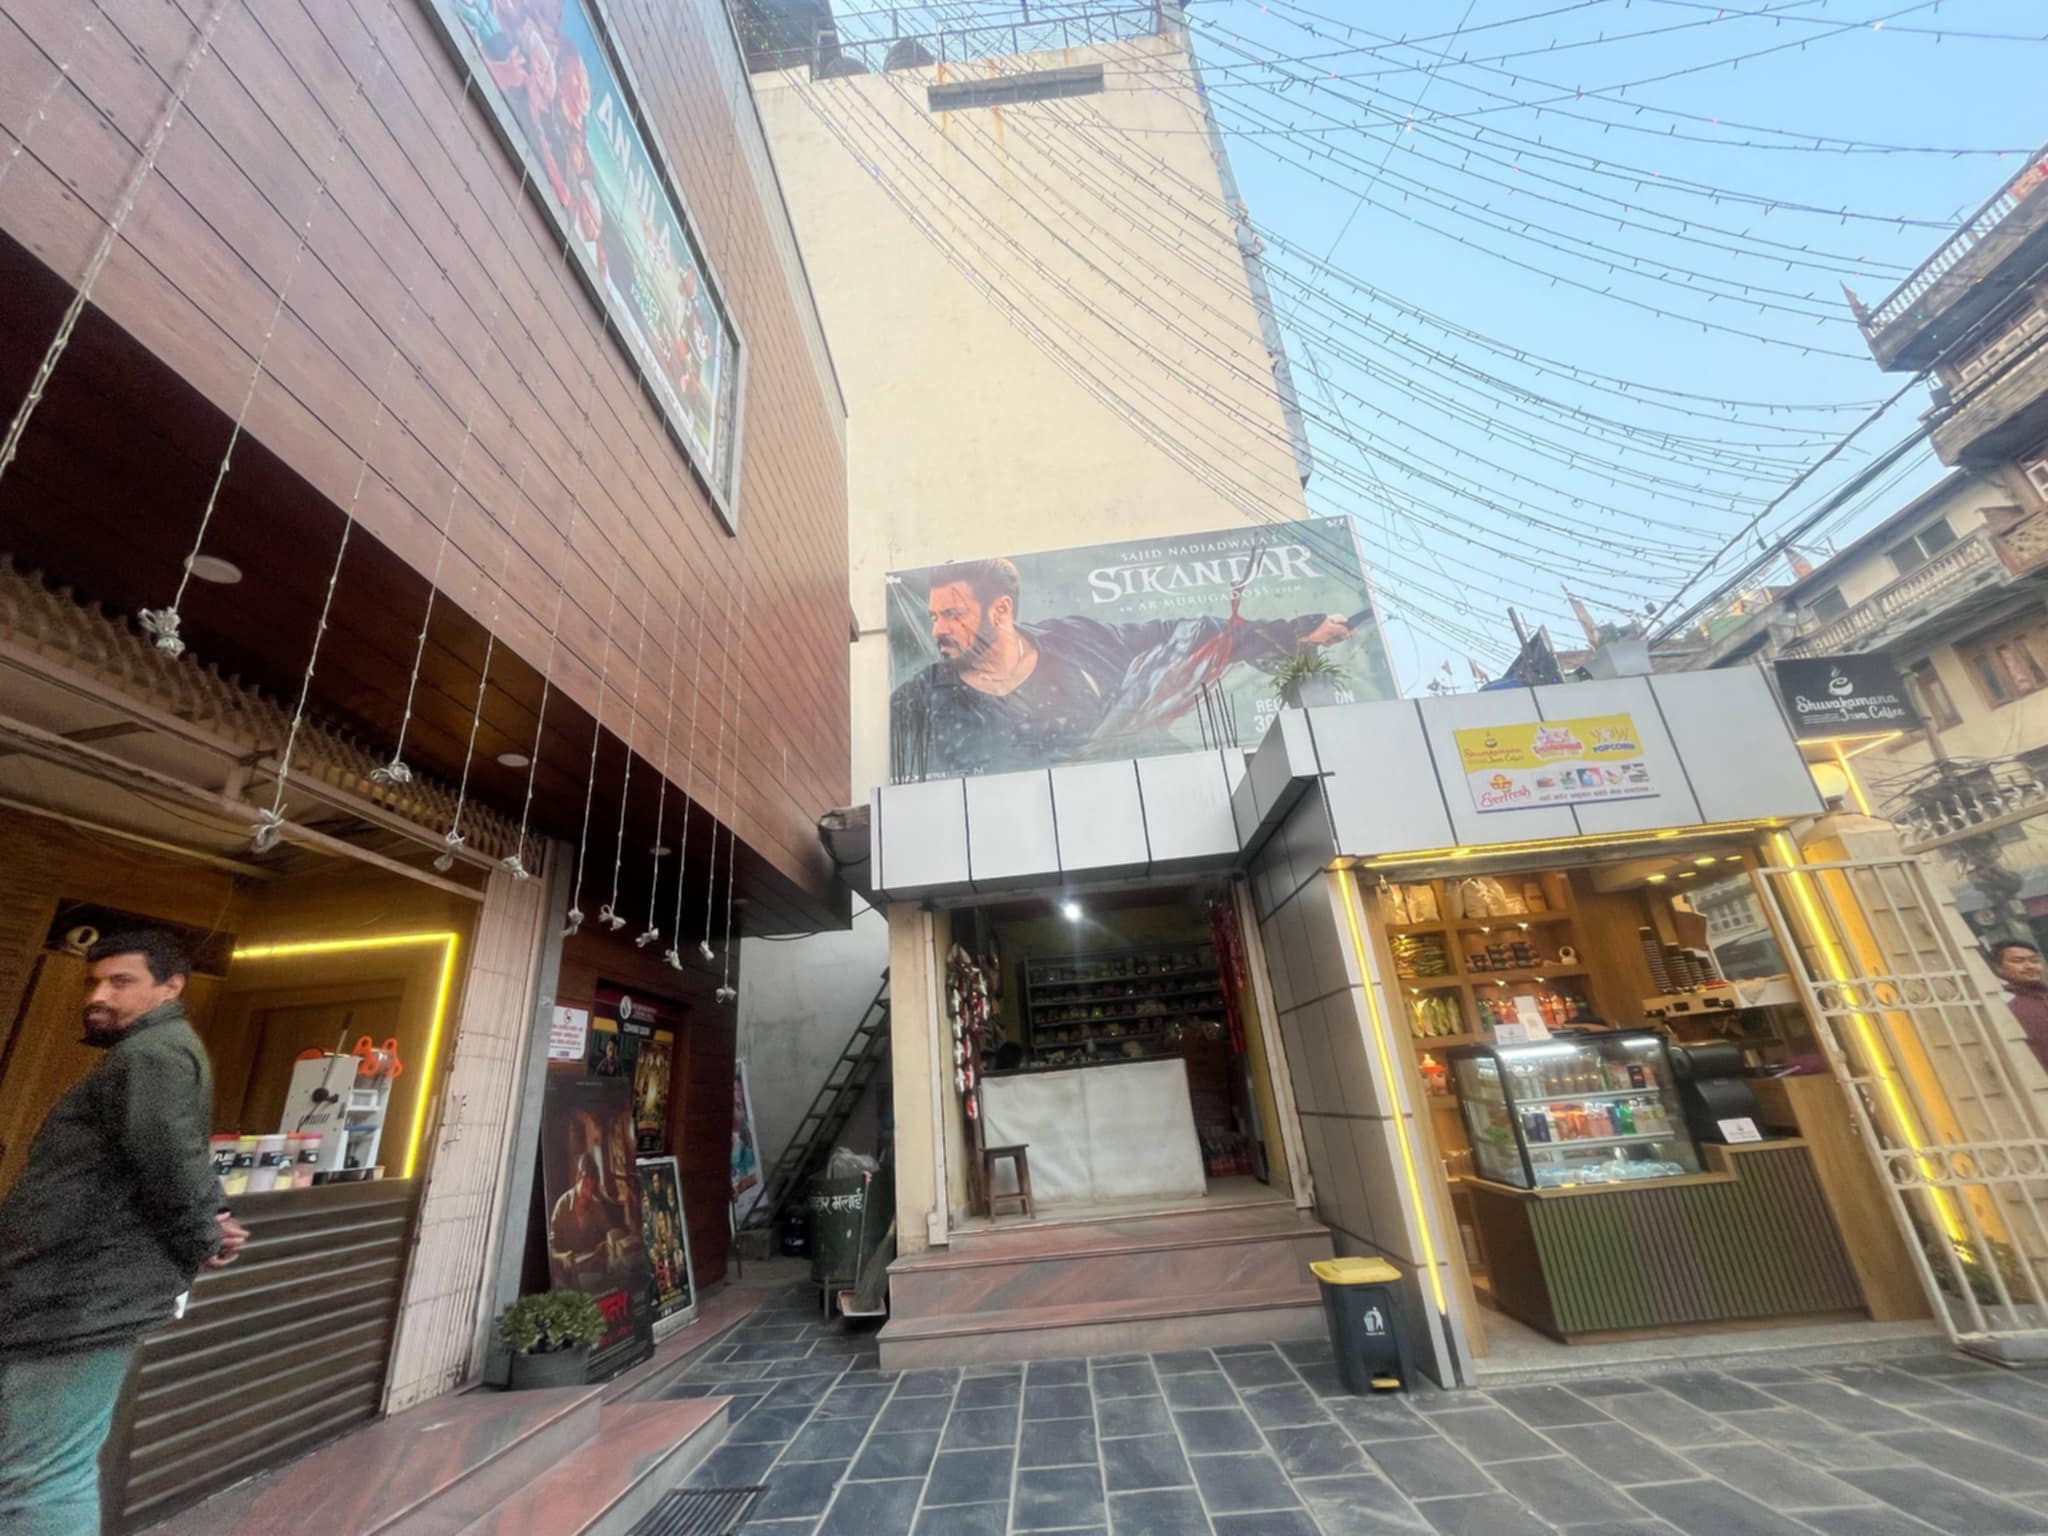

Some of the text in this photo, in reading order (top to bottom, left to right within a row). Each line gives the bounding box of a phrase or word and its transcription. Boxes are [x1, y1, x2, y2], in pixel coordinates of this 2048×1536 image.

[1120, 549, 1163, 562] SAJID
[1087, 544, 1325, 604] SIKANDAR
[1795, 694, 1899, 713] Shuvakamana
[1869, 705, 1906, 720] Coffee
